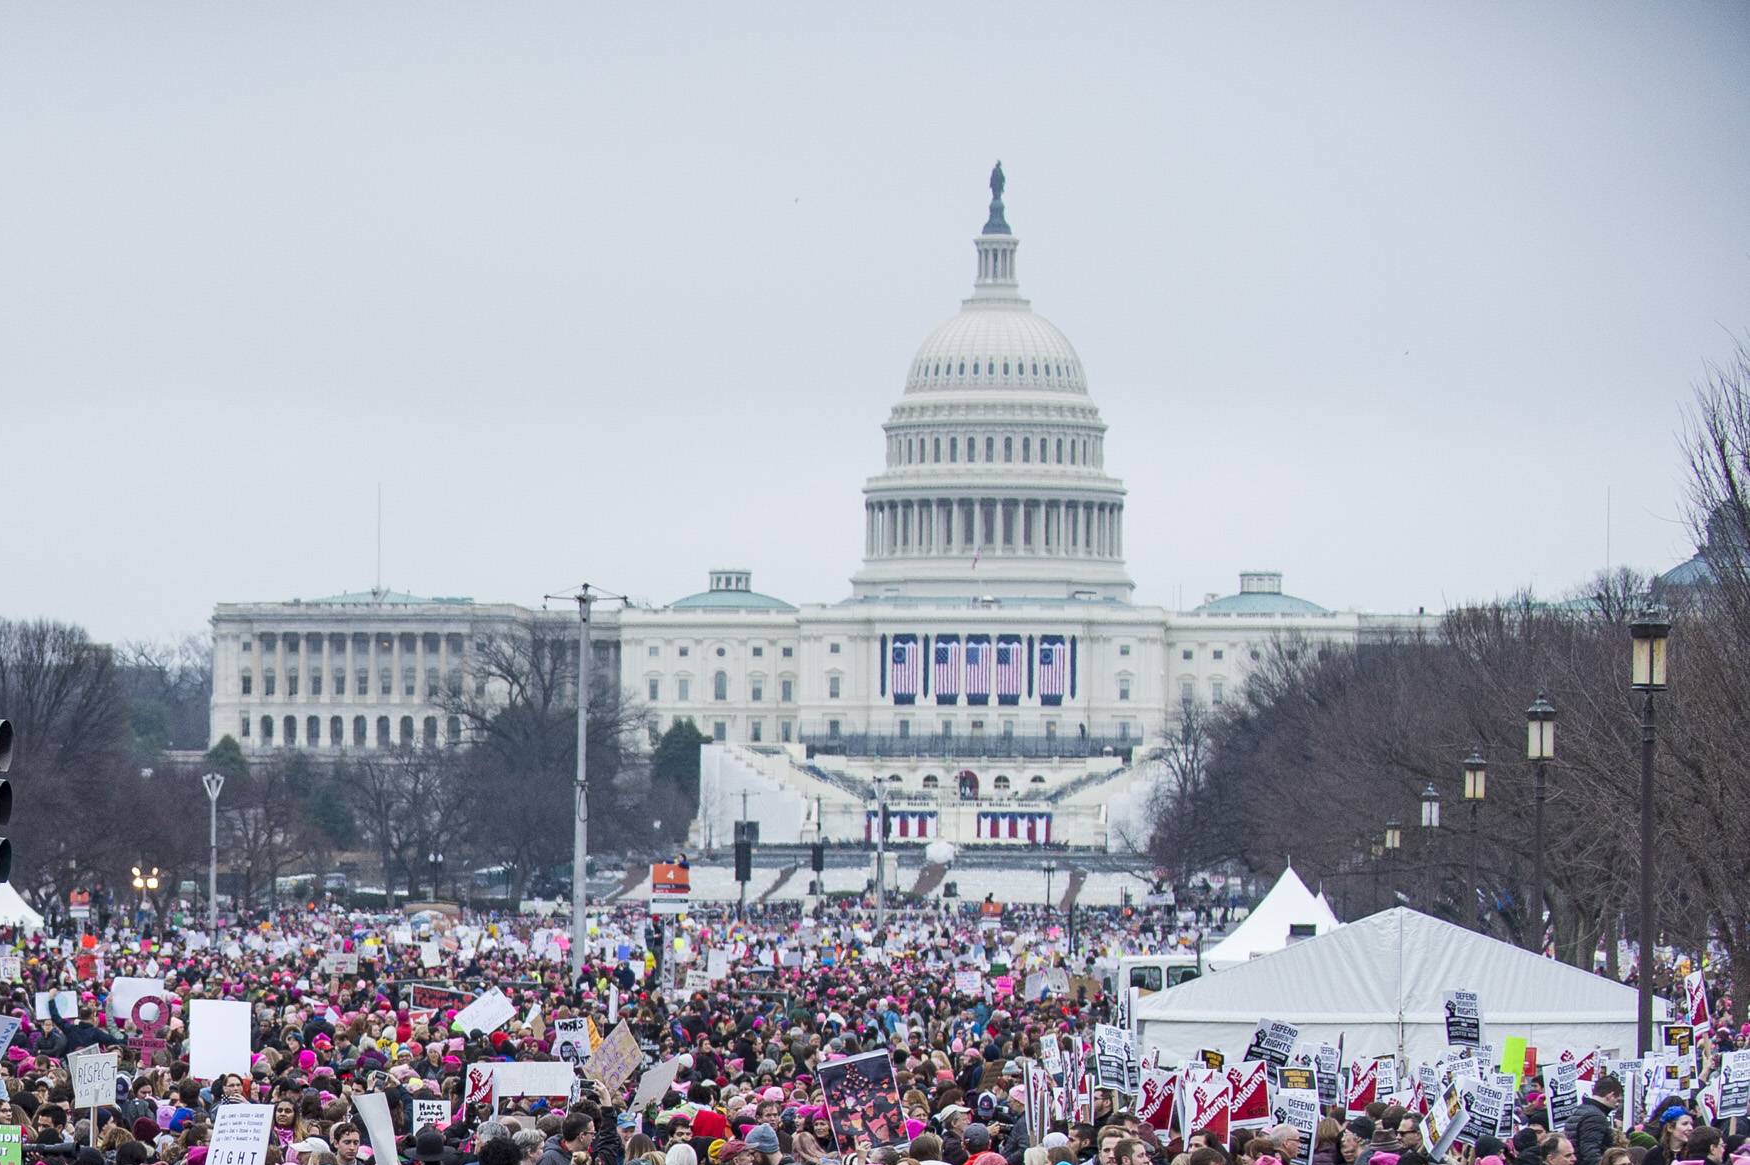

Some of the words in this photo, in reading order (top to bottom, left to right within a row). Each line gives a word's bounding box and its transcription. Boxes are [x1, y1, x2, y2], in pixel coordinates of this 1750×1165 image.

[1456, 991, 1478, 1001] DEFEND
[1457, 1007, 1479, 1017] RIGHTS
[1271, 1023, 1299, 1038] DEFEND
[1264, 1038, 1292, 1054] RIGHTS
[78, 1061, 117, 1084] RESPECT
[1619, 1061, 1642, 1070] DEFEND
[1230, 1068, 1266, 1113] Solidarity
[1348, 1066, 1378, 1103] Solidarity
[1477, 1085, 1503, 1100] DEFEND
[418, 1102, 442, 1112] Hate
[1137, 1081, 1175, 1122] Solidarity
[1288, 1099, 1316, 1112] DEFEND
[1191, 1093, 1230, 1131] Solidarity
[1474, 1102, 1500, 1117] RIGHTS
[1287, 1116, 1313, 1131] RIGHTS
